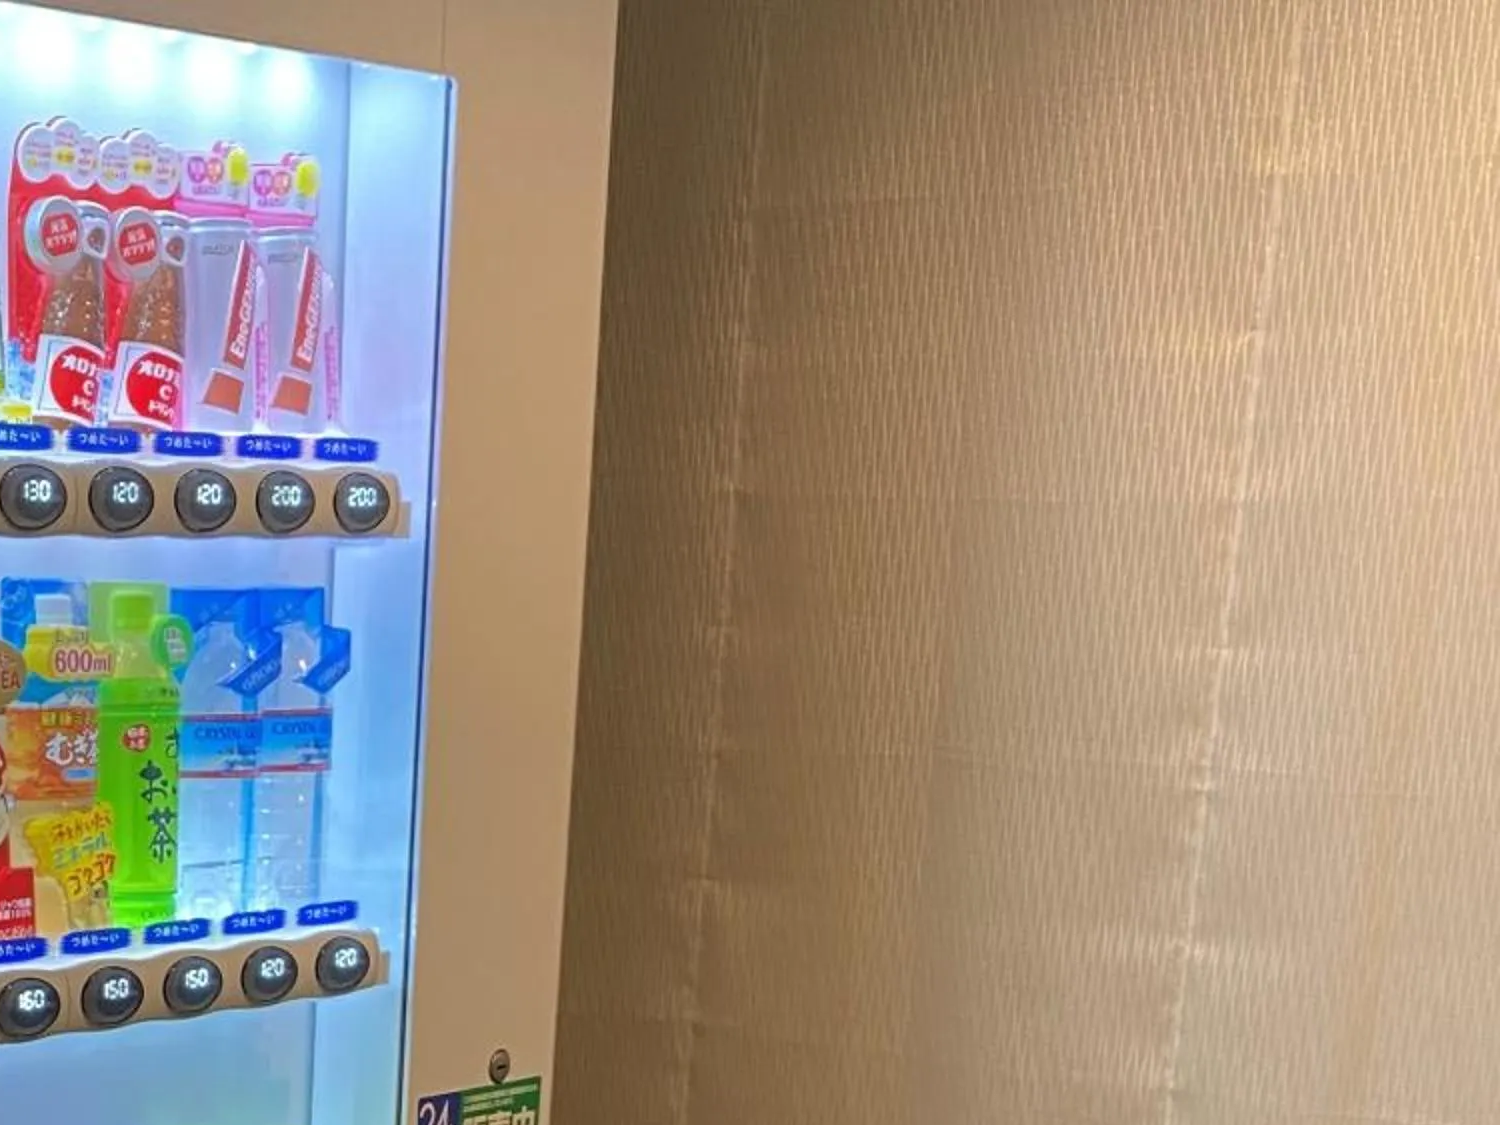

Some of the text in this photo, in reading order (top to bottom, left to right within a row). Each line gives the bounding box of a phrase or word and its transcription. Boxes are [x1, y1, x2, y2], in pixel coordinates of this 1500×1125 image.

[23, 479, 52, 502] 130
[112, 481, 140, 503] 120
[197, 483, 221, 505] 120
[271, 485, 301, 507] 200
[348, 487, 377, 507] 200
[54, 648, 112, 675] 600ml
[18, 989, 45, 1011] 160
[103, 978, 129, 999] 150
[184, 968, 209, 989] 150
[261, 957, 285, 978] 120
[334, 947, 357, 968] 120
